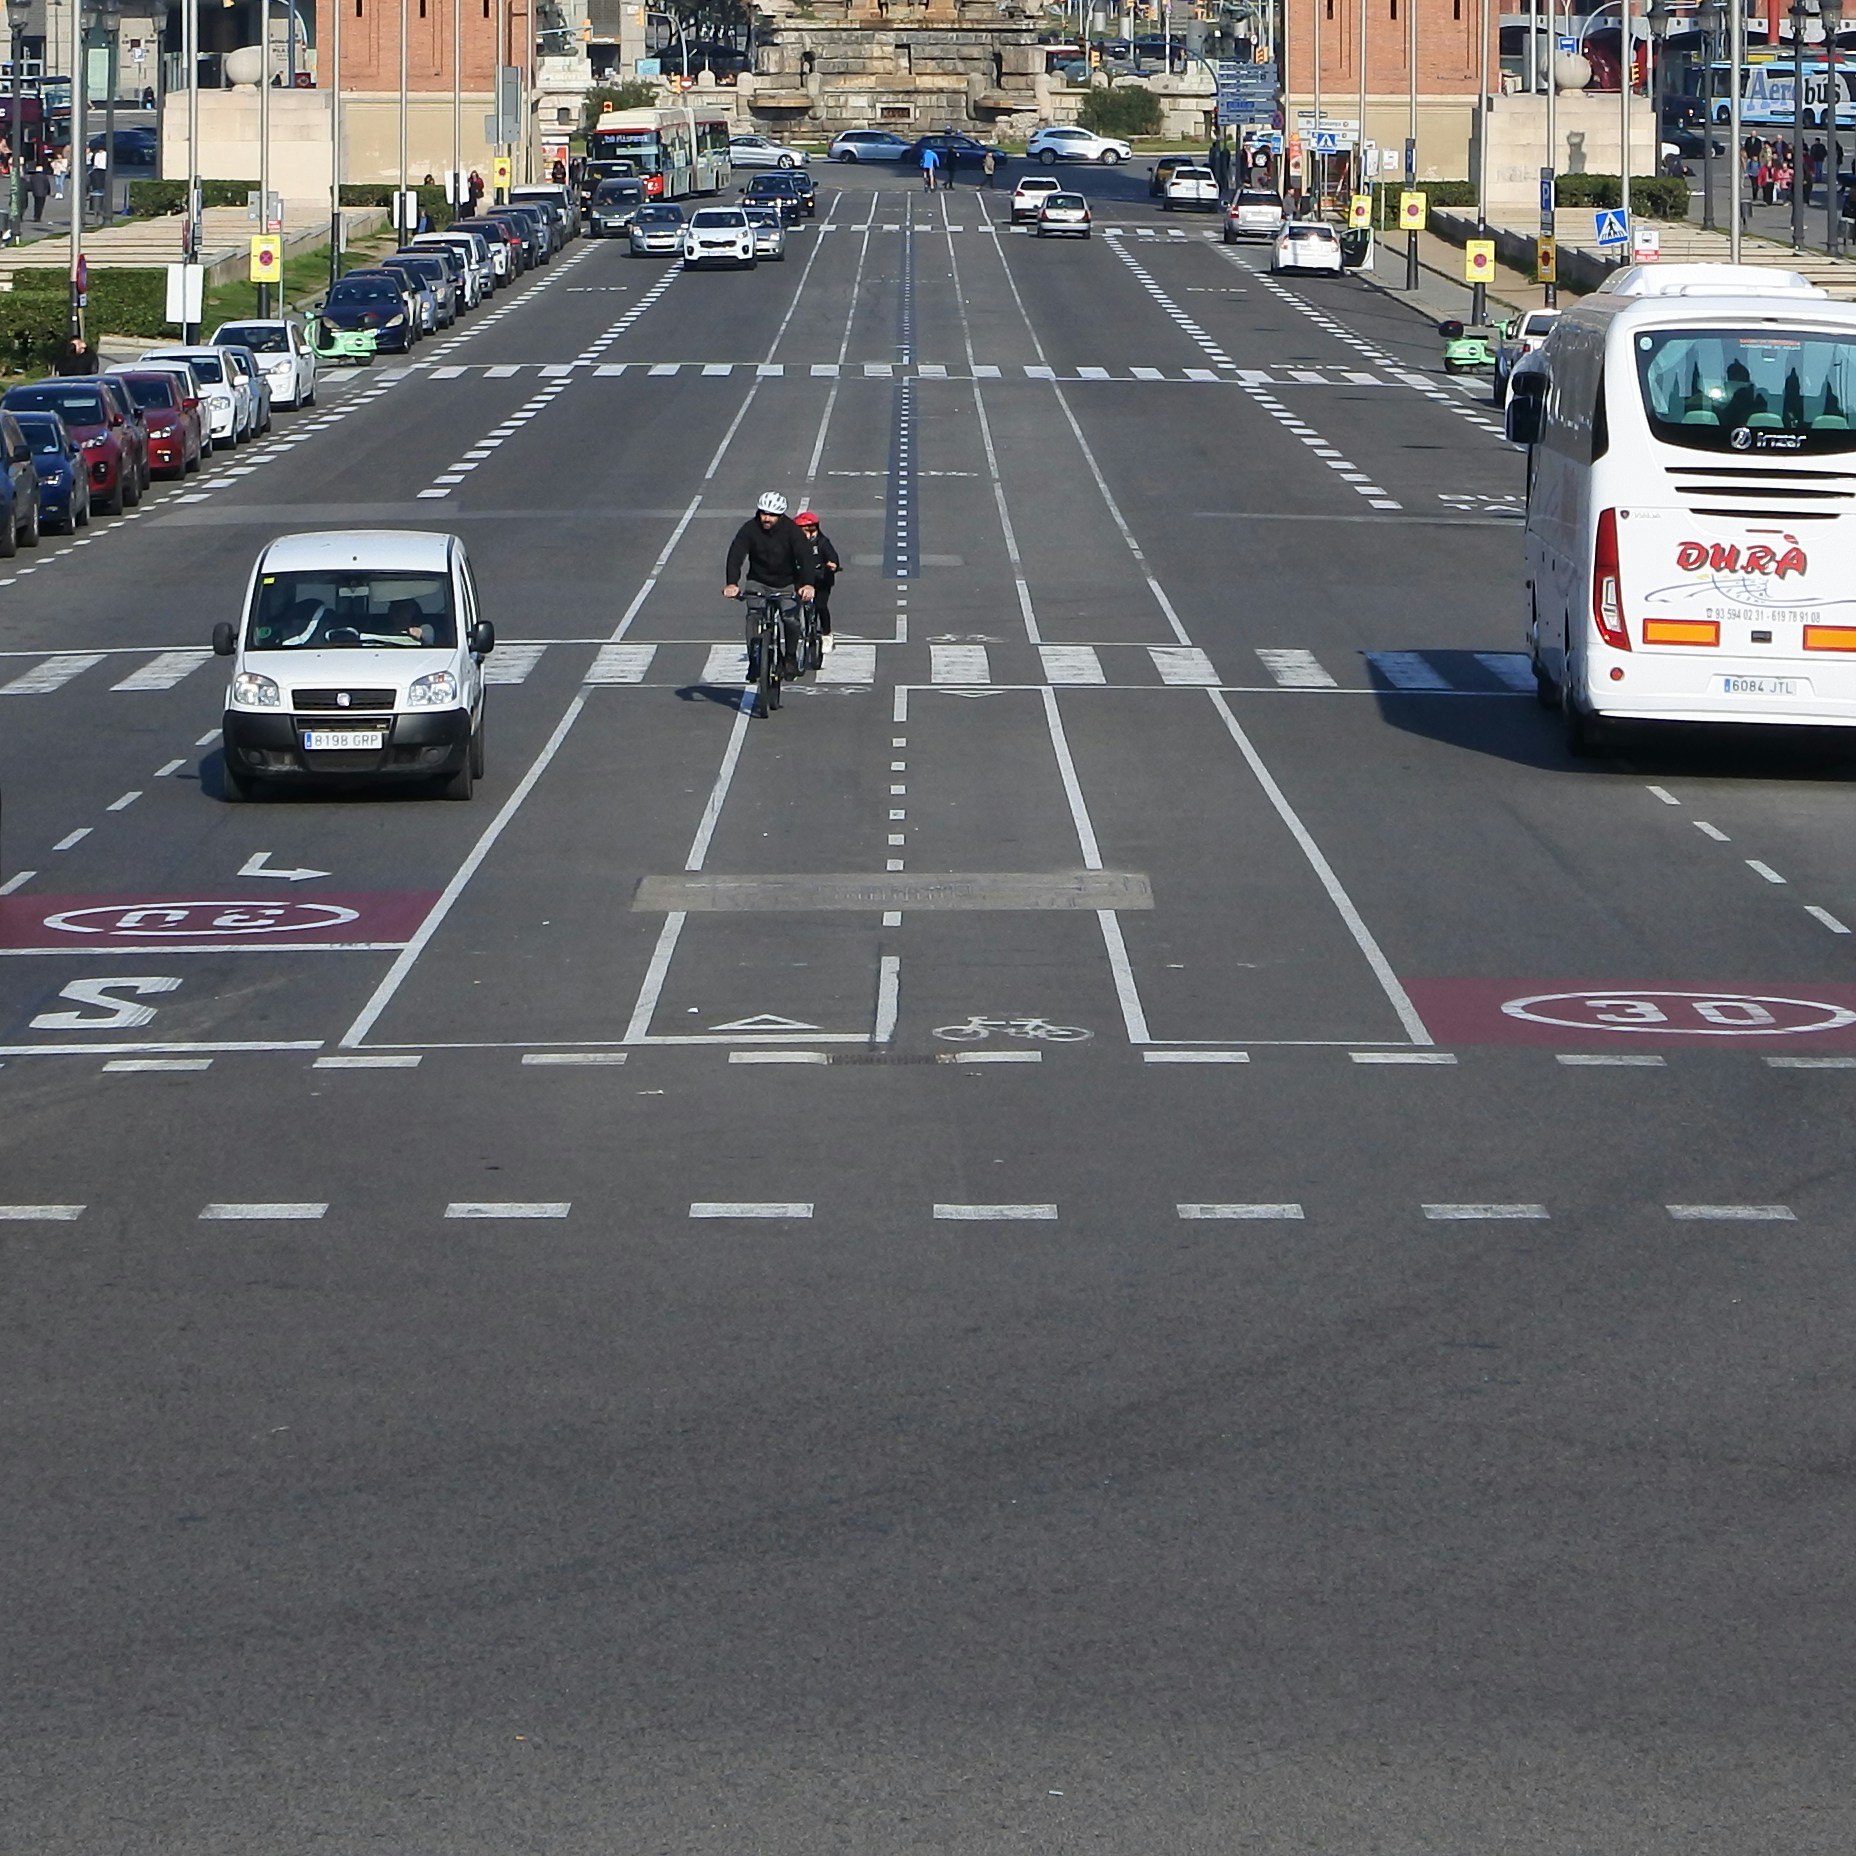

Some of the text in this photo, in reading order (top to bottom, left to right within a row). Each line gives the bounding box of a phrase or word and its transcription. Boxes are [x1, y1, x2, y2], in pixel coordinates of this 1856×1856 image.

[1542, 185, 1550, 208] P
[1715, 608, 1725, 619] 93
[1727, 608, 1741, 620] 594
[1743, 609, 1753, 621] 02
[1755, 609, 1764, 621] 31
[1788, 611, 1798, 622] 78
[1800, 611, 1809, 623] 91
[1732, 680, 1793, 694] 6084 JTL
[314, 735, 379, 747] 8198 GRP
[1586, 999, 1776, 1027] 30
